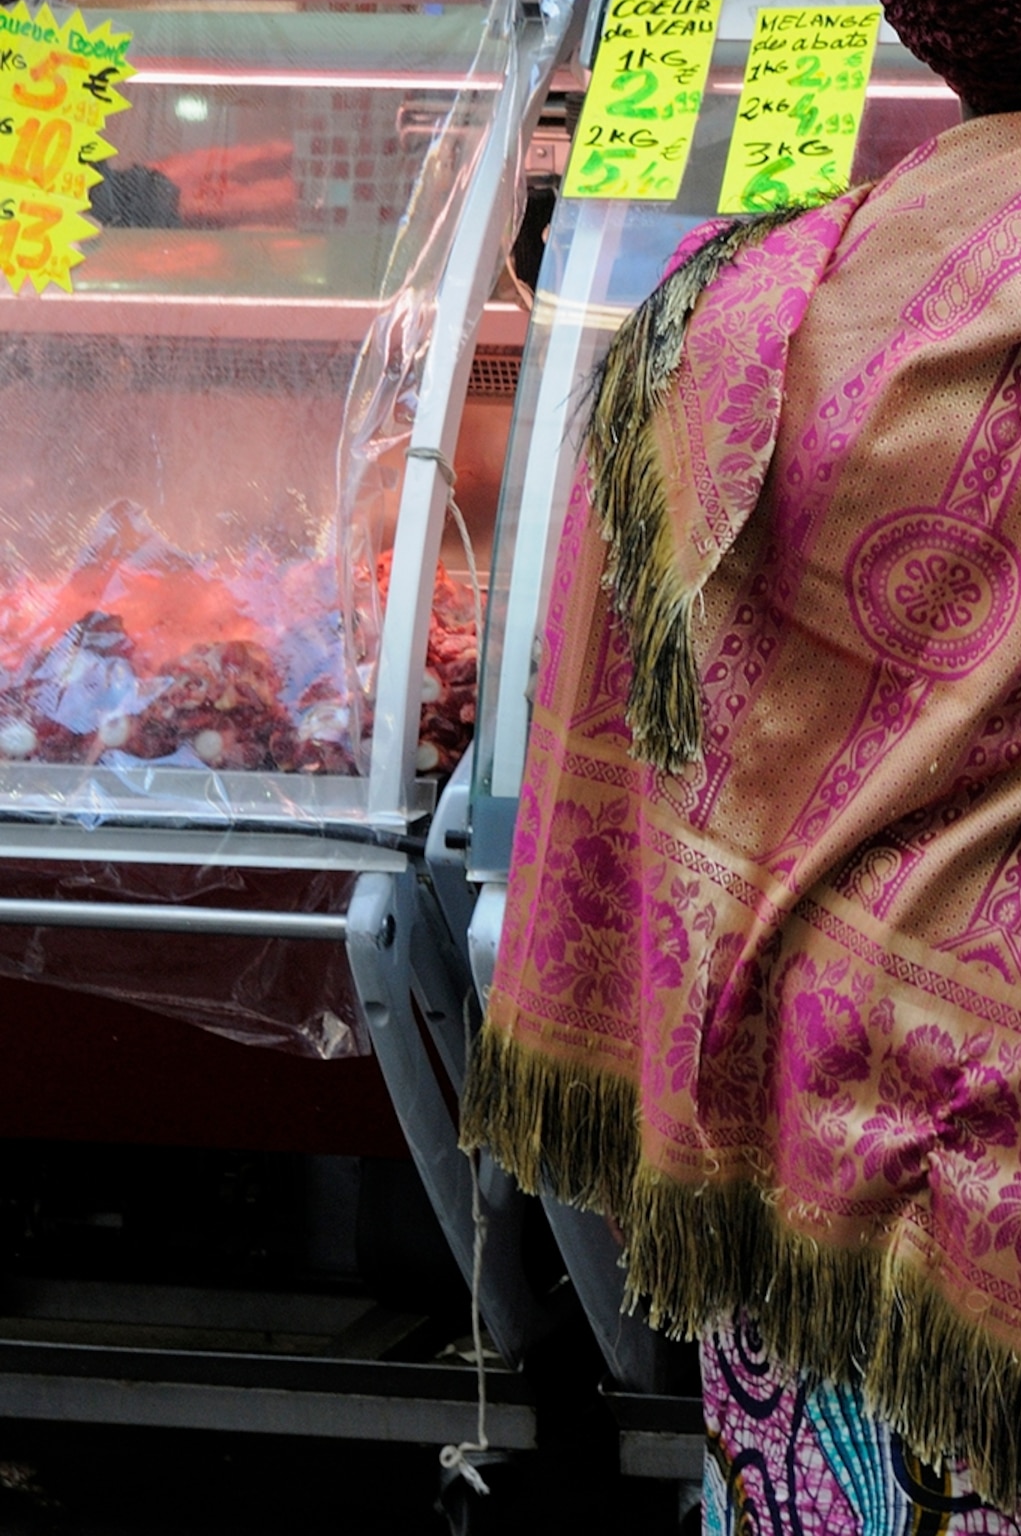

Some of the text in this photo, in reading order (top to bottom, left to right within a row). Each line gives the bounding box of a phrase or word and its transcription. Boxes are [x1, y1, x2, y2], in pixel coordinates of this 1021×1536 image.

[612, 0, 710, 18] COEUR
[603, 20, 712, 42] de VEAU
[760, 12, 881, 33] MELANGE
